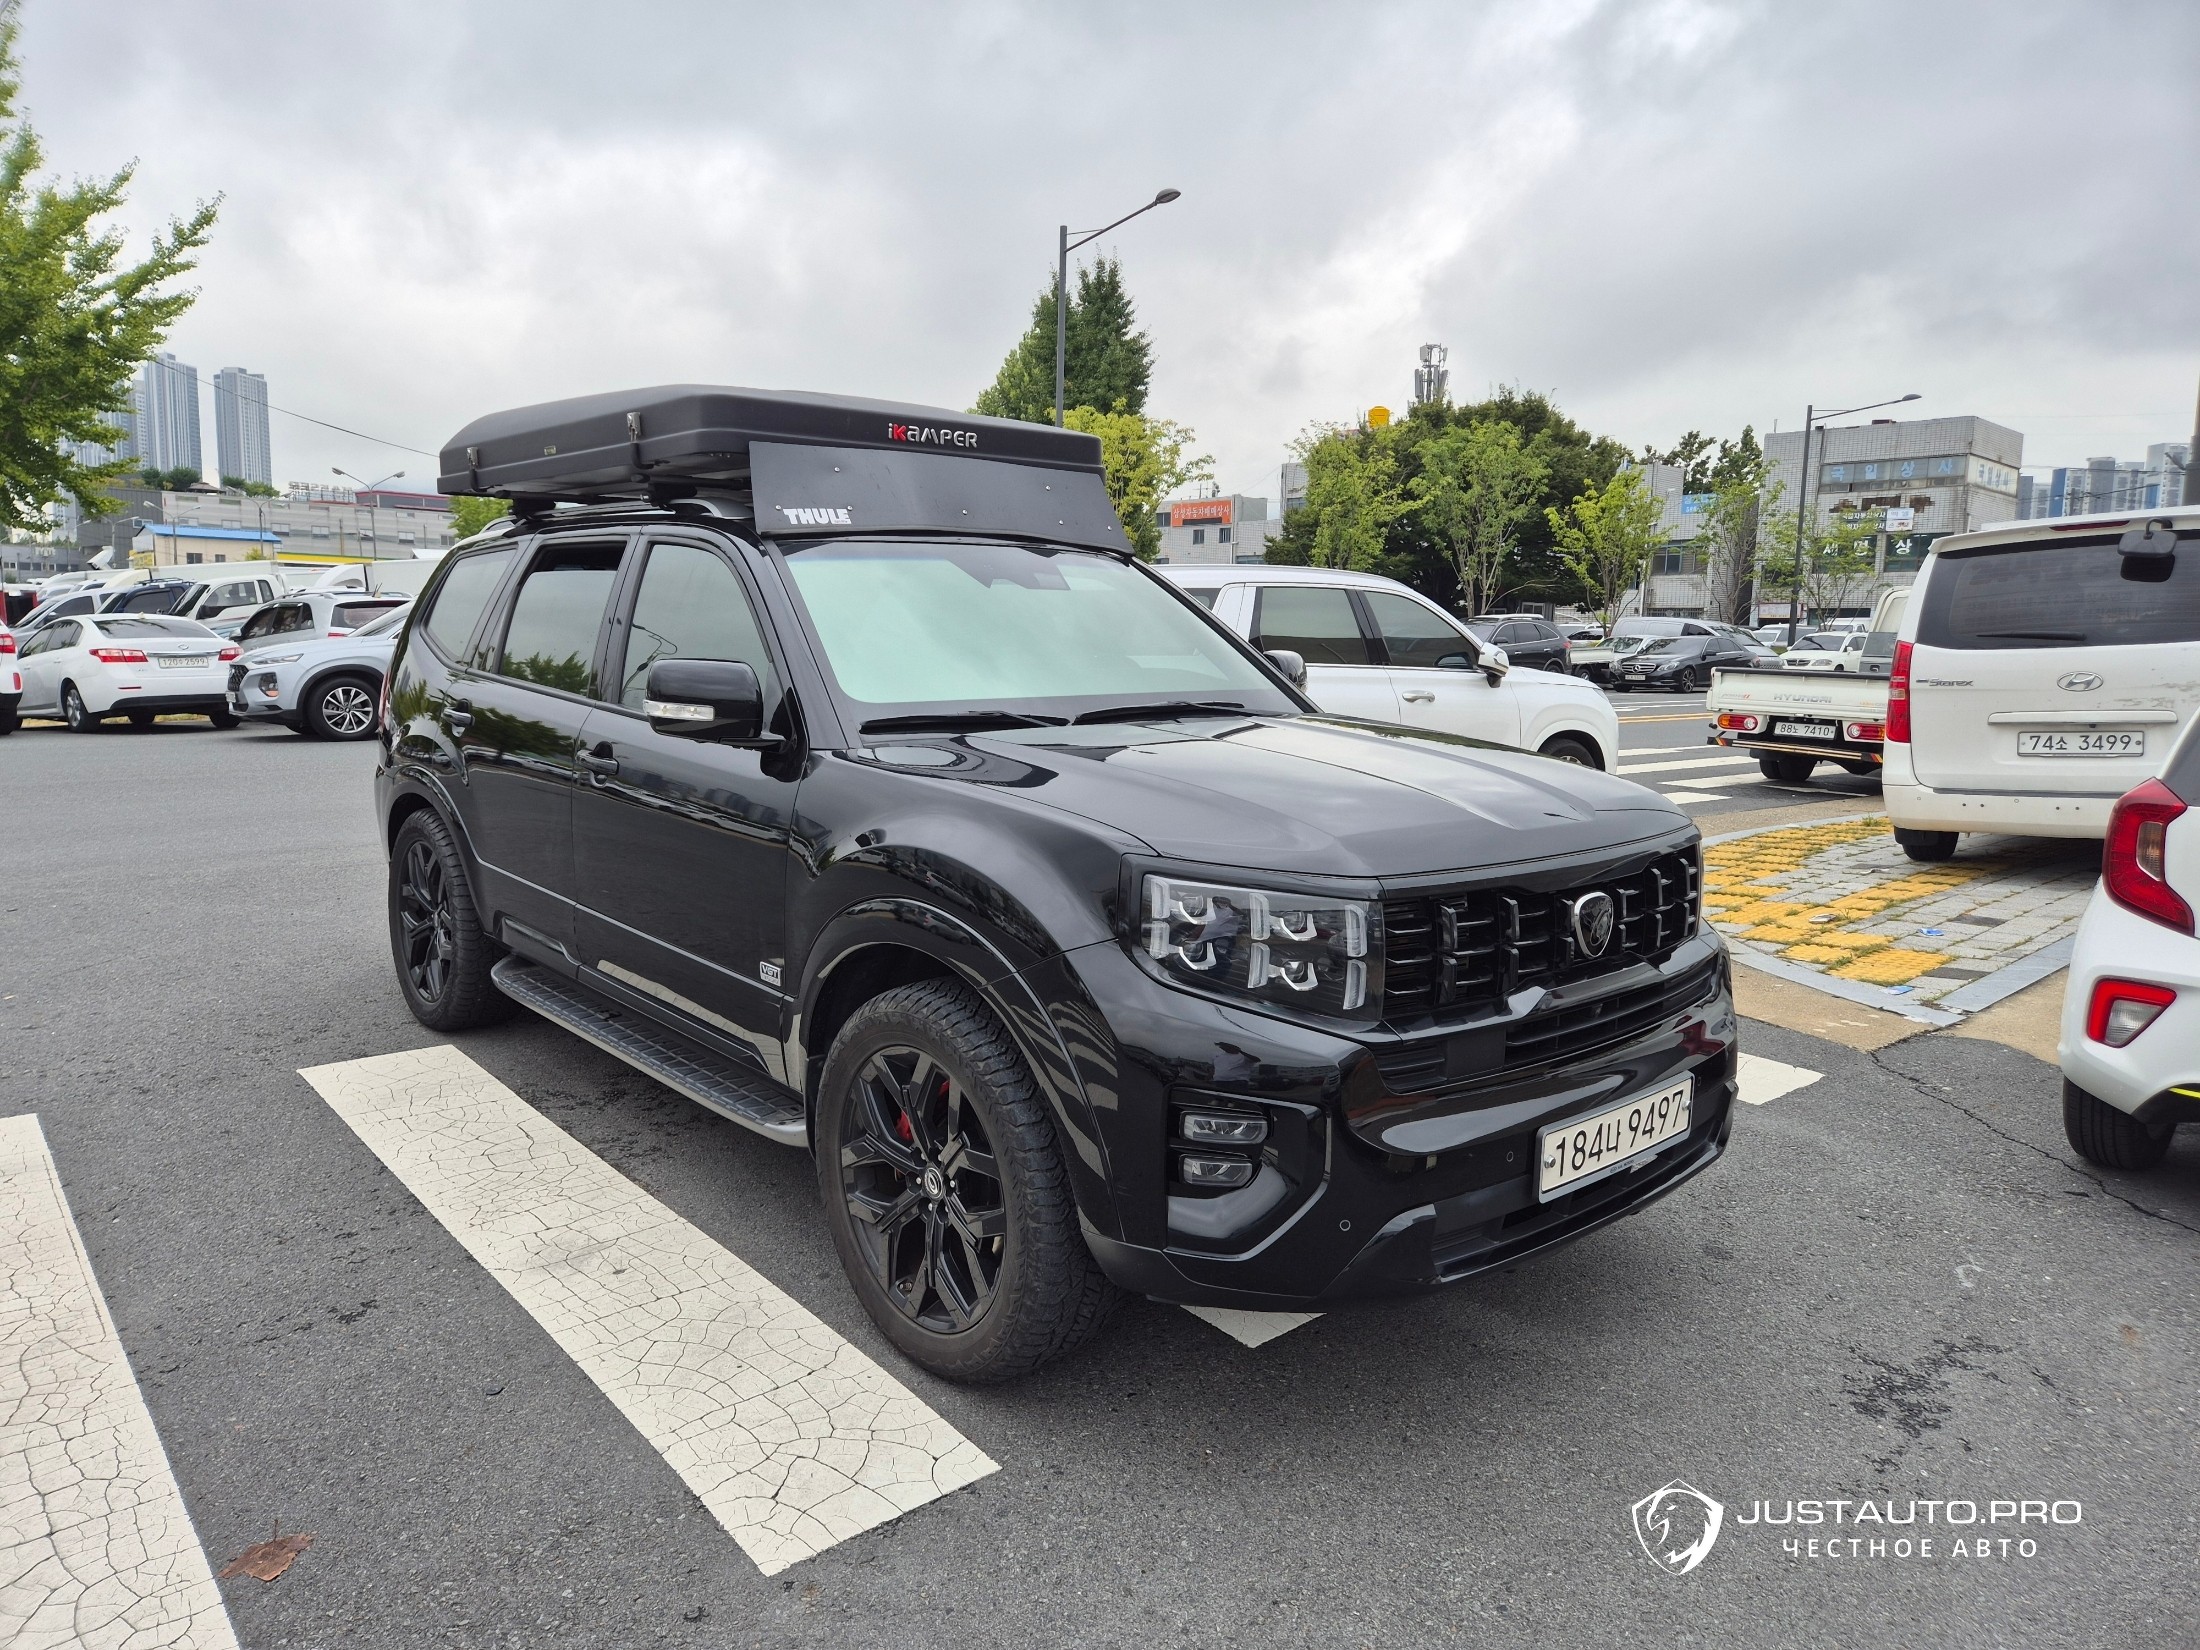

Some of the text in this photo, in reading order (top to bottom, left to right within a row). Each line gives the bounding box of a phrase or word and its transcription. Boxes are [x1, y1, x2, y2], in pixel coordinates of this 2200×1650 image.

[1831, 460, 1953, 484] 국일상사
[783, 508, 852, 525] THULE
[1929, 678, 1974, 687] Starex
[1774, 693, 1832, 703] HYUNDAI
[1780, 724, 1830, 737] 88노 7410
[2029, 734, 2132, 751] 74소 3499
[762, 965, 778, 978] VGT
[1556, 1089, 1684, 1177] 184나 9497
